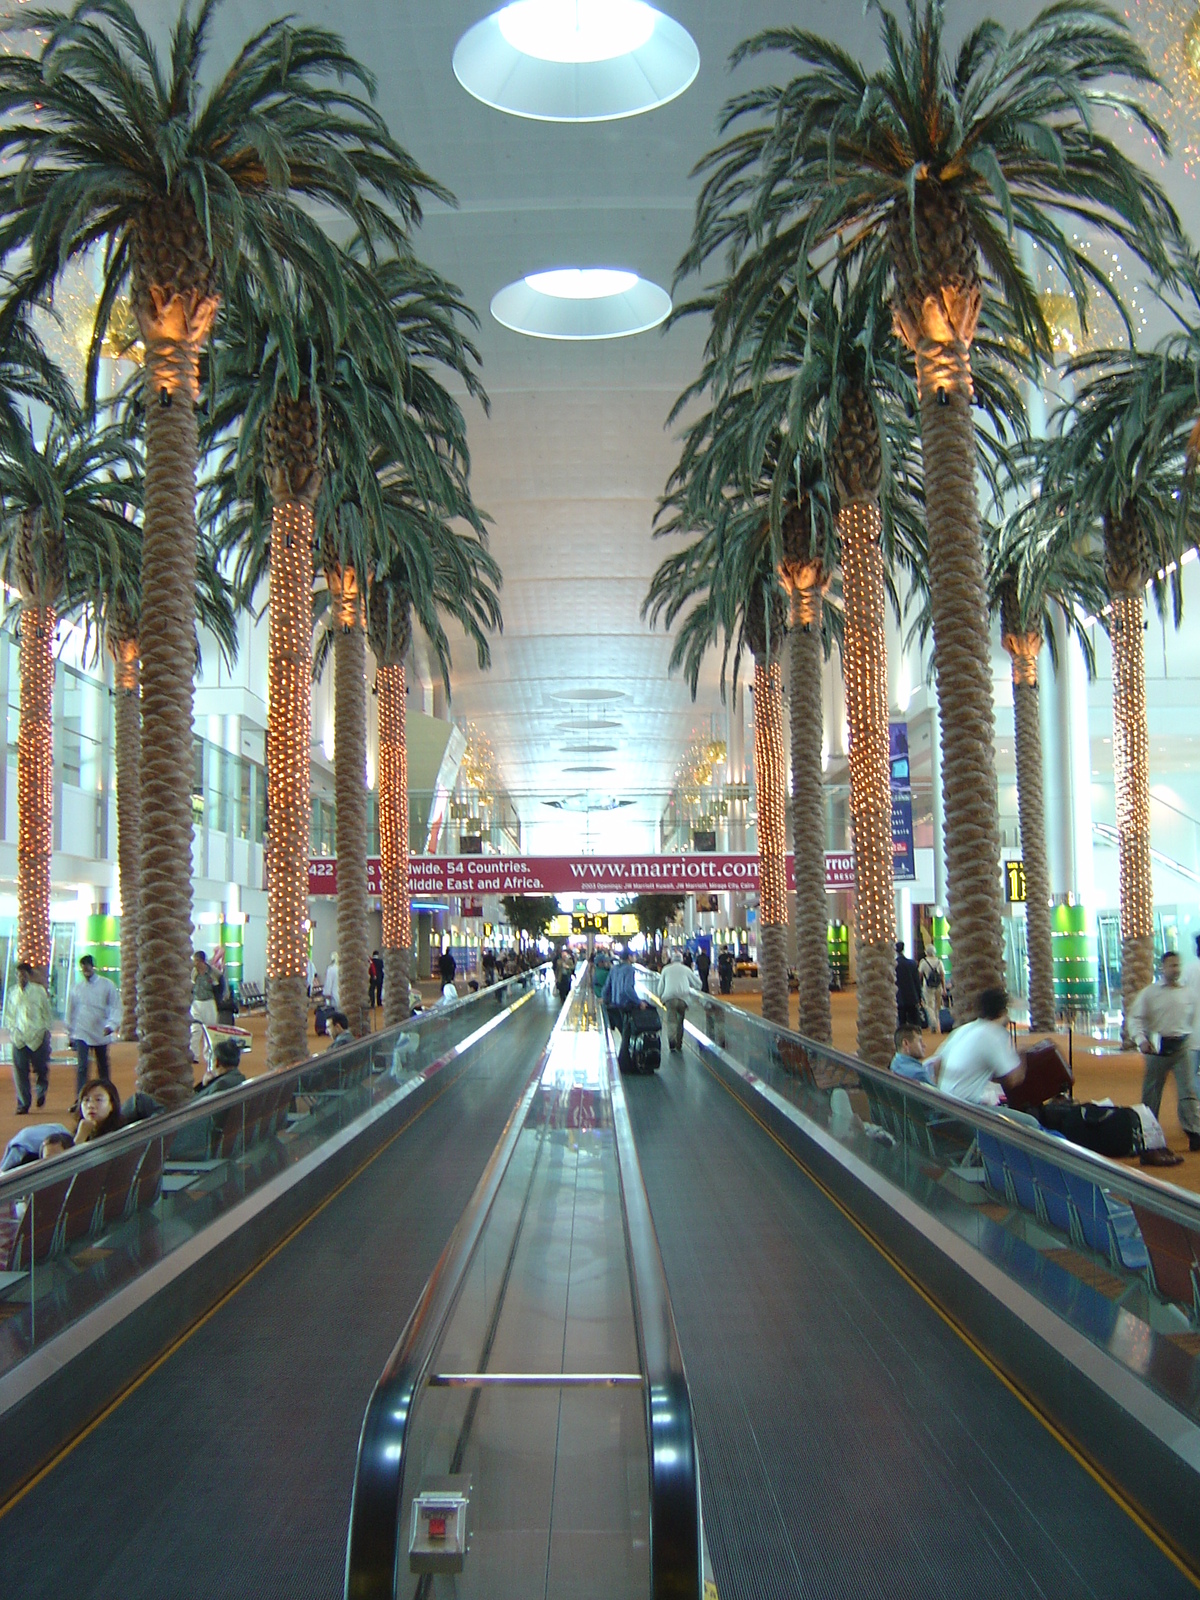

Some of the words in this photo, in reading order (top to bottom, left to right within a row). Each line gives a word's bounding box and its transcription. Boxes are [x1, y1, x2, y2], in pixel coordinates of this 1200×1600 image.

[447, 862, 464, 874] 54
[467, 861, 531, 874] Countries.
[569, 857, 760, 877] www.marriott.com
[447, 878, 474, 890] East
[478, 877, 500, 890] and
[503, 876, 544, 889] Africa.
